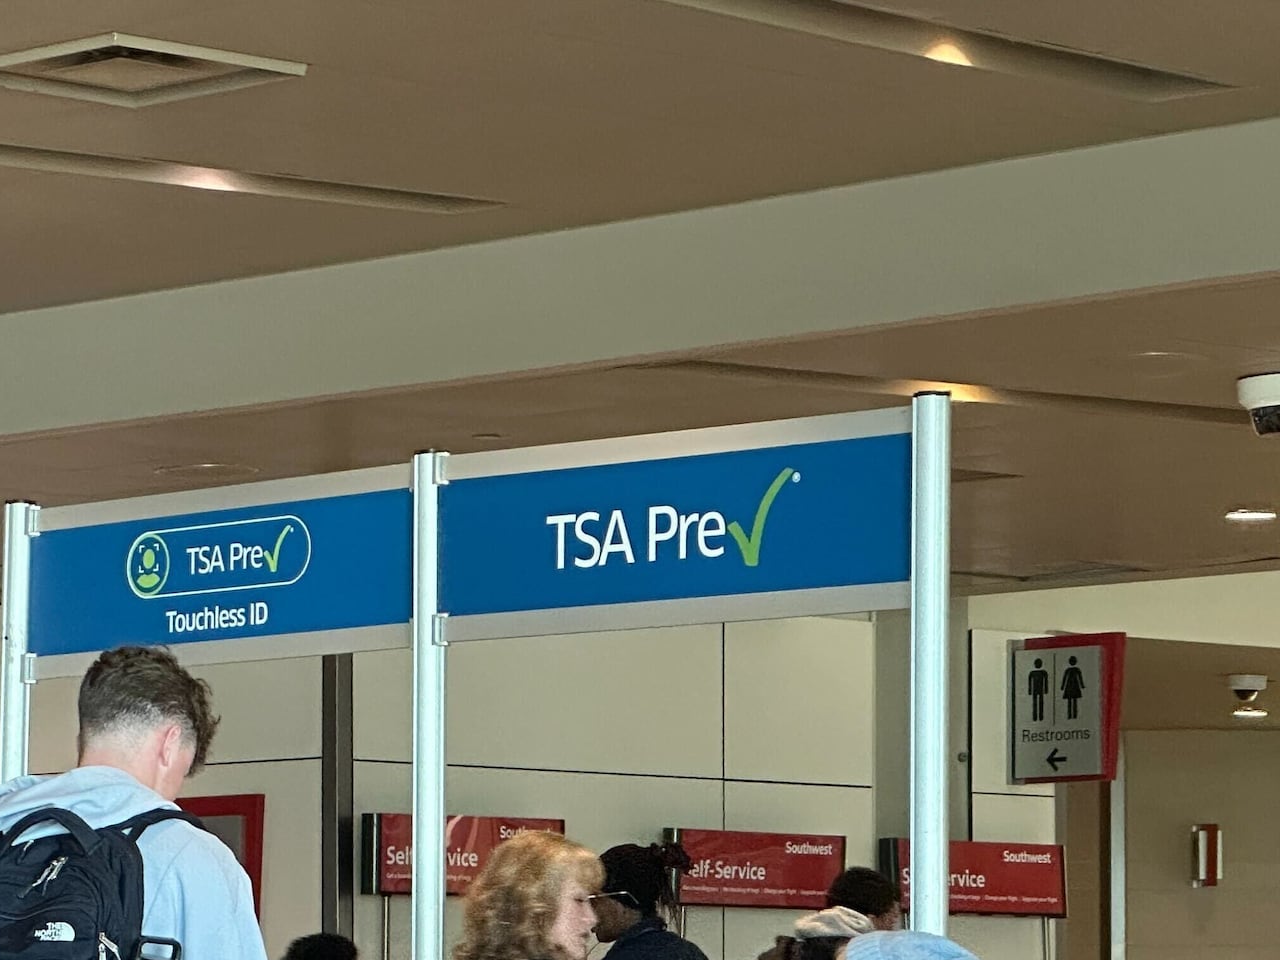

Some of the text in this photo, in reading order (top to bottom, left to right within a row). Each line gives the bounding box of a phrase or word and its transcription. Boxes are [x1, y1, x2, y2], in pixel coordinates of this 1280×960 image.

[546, 504, 726, 569] TSA Pre
[186, 544, 225, 575] TSA
[166, 602, 268, 633] Touchless ID
[1022, 728, 1090, 742] Restrooms
[784, 840, 833, 856] Southwest
[1003, 850, 1052, 864] Southwest
[688, 859, 766, 880] elf-Service
